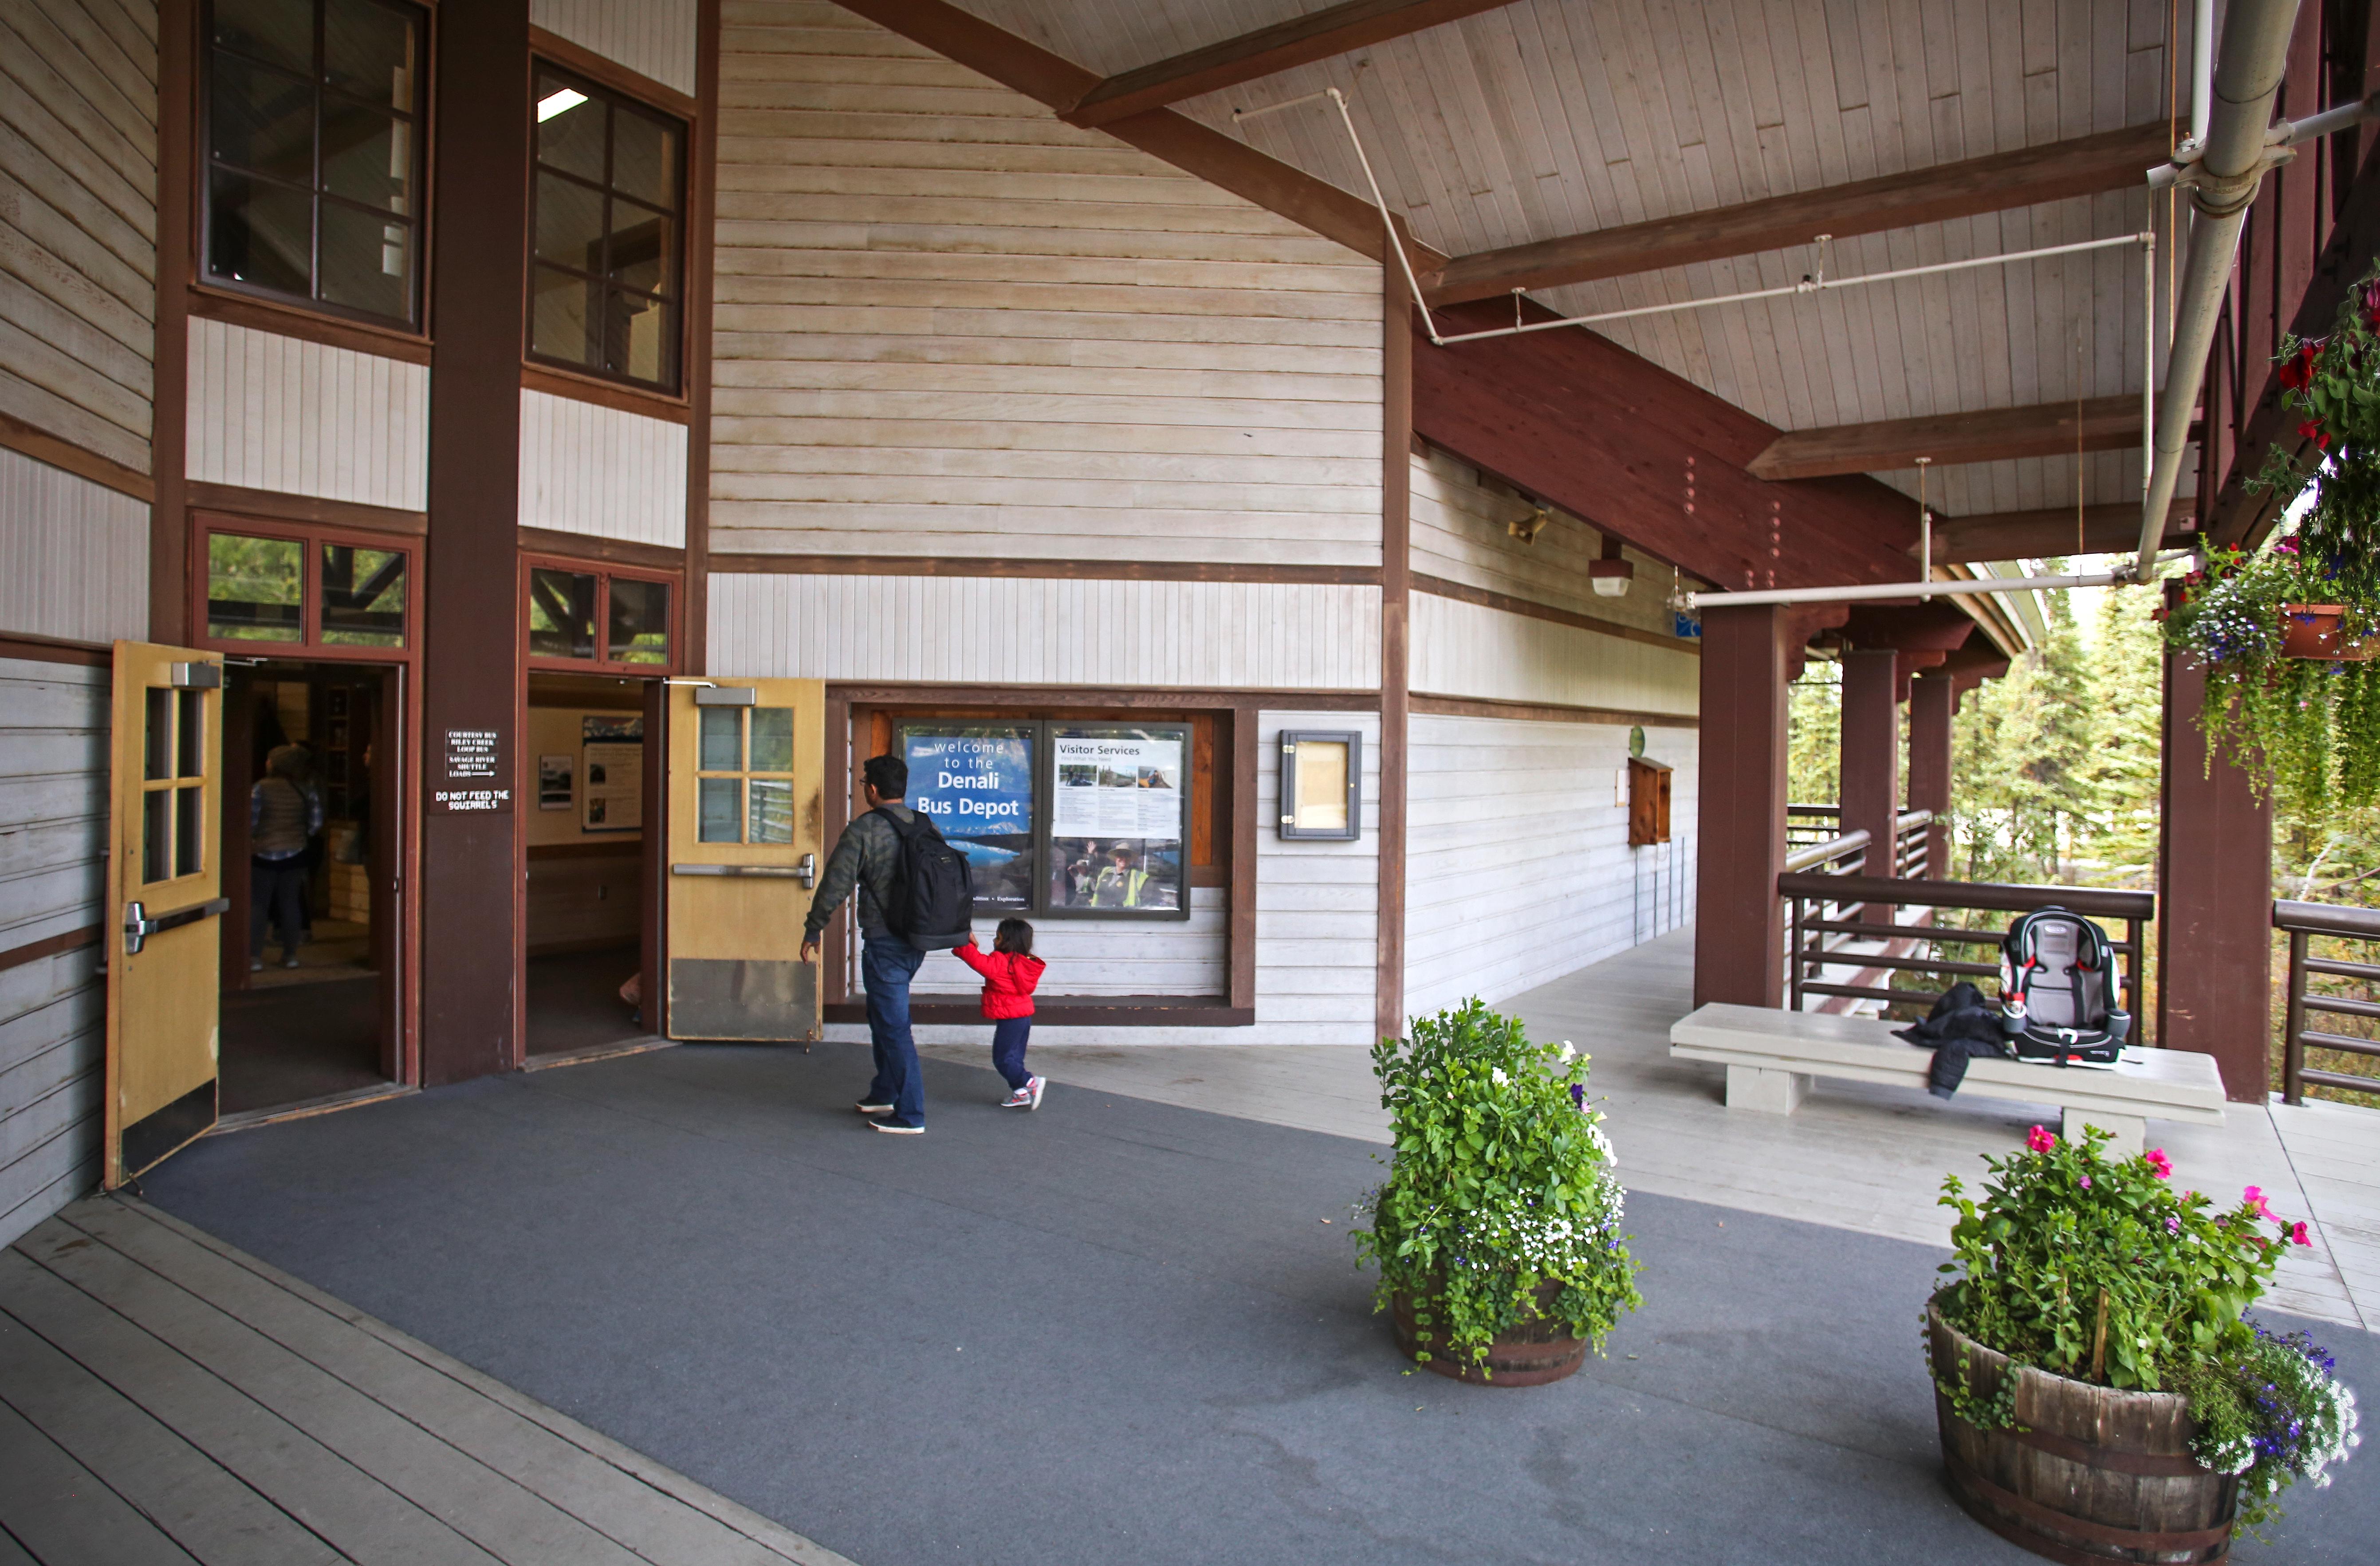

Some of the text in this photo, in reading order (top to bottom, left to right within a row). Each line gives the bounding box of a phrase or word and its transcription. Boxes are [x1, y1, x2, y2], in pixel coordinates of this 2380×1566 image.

[934, 741, 1004, 754] welcome
[1060, 745, 1140, 755] Visitor Services
[945, 757, 993, 769] to the
[938, 772, 999, 789] Denali
[436, 790, 509, 801] DO NOT FEED THE
[448, 800, 497, 810] SQUIRRELS
[918, 797, 1019, 819] Bus Depot
